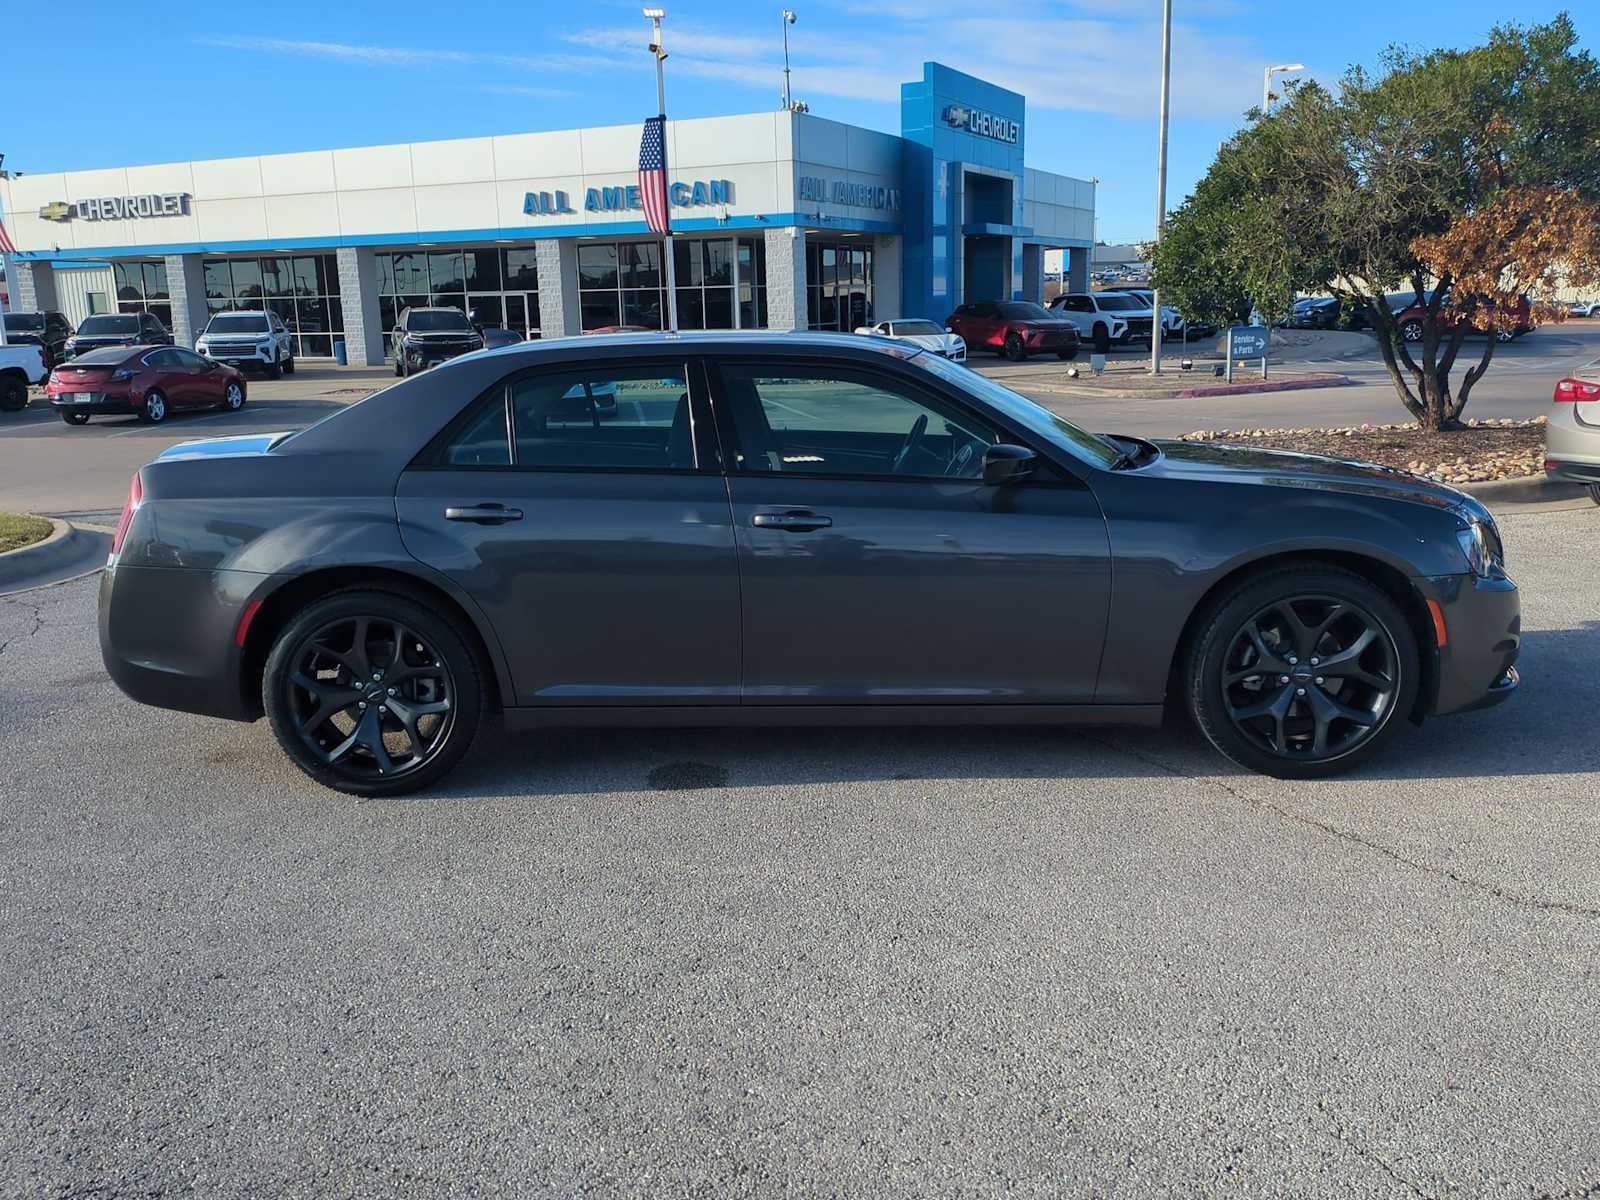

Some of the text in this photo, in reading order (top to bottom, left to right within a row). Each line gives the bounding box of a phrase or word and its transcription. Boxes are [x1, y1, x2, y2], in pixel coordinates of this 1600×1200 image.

[970, 109, 1019, 144] CHEVROLET
[76, 193, 185, 221] CHEVROLET
[523, 179, 732, 215] ALL AMECAN
[1233, 335, 1255, 343] Service
